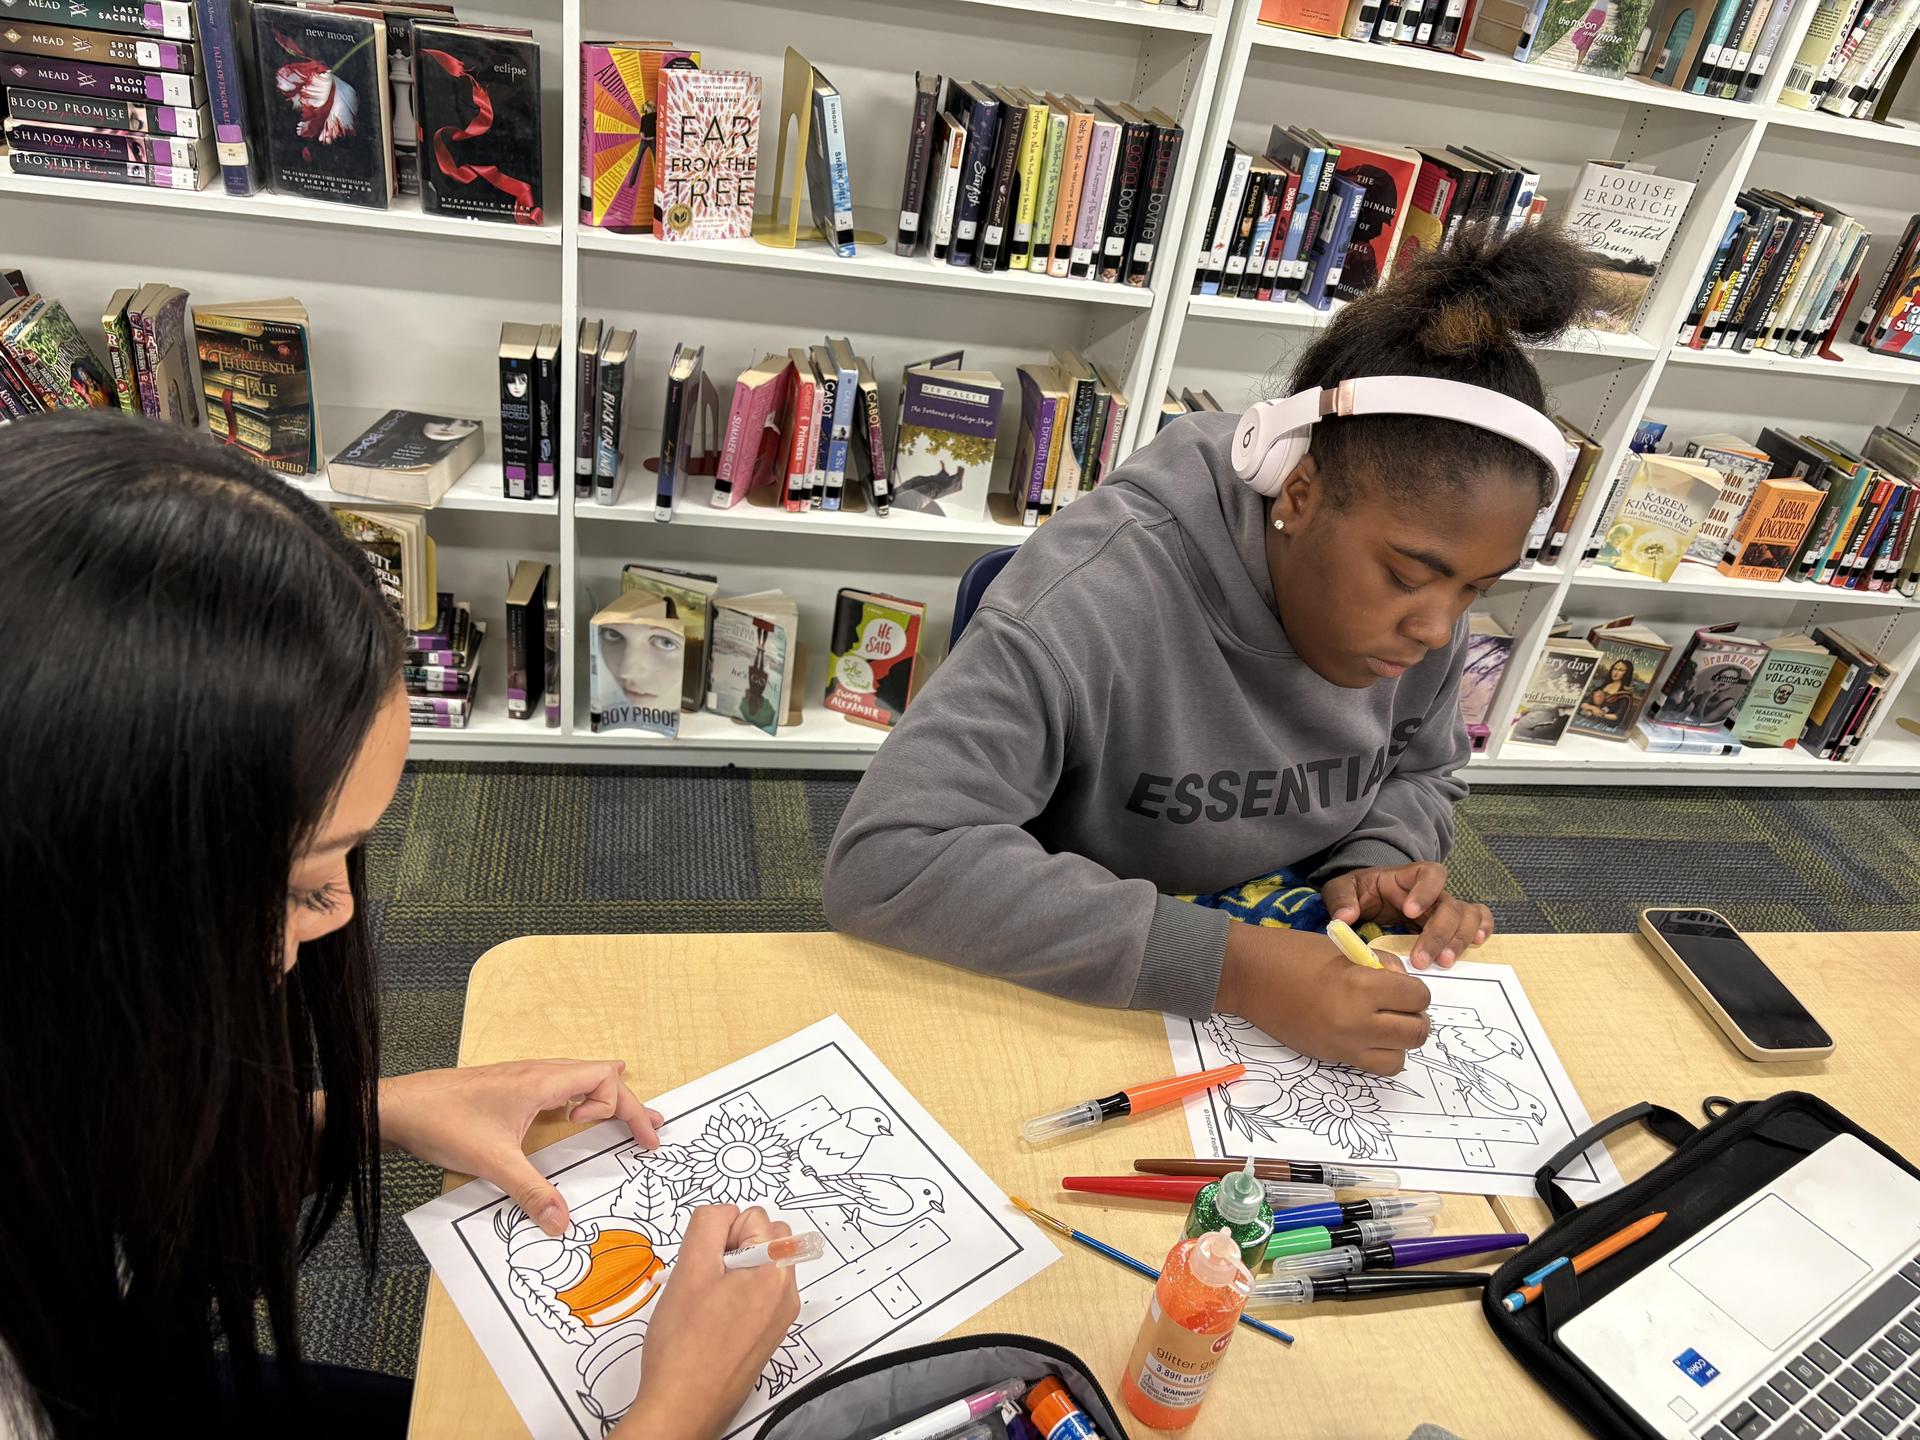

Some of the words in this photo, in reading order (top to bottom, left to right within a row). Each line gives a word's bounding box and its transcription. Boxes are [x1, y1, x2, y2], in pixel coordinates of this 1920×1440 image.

[113, 6, 139, 14] LAST
[1558, 17, 1571, 25] the
[1570, 18, 1597, 30] moon
[1739, 10, 1750, 36] PURE
[32, 35, 64, 46] MEAD
[305, 28, 324, 38] new
[326, 30, 356, 44] moon
[1593, 33, 1623, 44] more
[1732, 36, 1741, 50] CRY
[38, 69, 69, 81] MEAD
[114, 76, 146, 86] BLOO
[494, 63, 527, 83] eclipse
[11, 97, 58, 111] BLOOD
[65, 103, 125, 119] PROMISE
[695, 96, 715, 104] ROBIN
[716, 96, 740, 104] BENWAY
[830, 102, 838, 134] BINGHAM
[13, 130, 75, 145] SHADOW
[82, 137, 111, 149] KISS
[680, 115, 751, 149] FAR
[1128, 130, 1149, 138] BRAY
[15, 154, 91, 170] FROSTBITE
[672, 156, 720, 172] FROM
[726, 156, 756, 172] THE
[834, 152, 845, 181] SHARK
[1120, 144, 1143, 185] going
[282, 175, 337, 188] STEPHENIE
[342, 184, 372, 193] MEYER
[965, 161, 987, 207] Starfish
[1319, 162, 1336, 192] DRAPER
[1357, 175, 1375, 185] THE
[669, 176, 754, 208] TREE
[837, 182, 847, 202] GIRL
[1599, 174, 1677, 201] LOUISE
[441, 197, 495, 208] STEPHENIE
[501, 203, 531, 212] MEYER
[1248, 185, 1260, 215] DRAPER
[1282, 188, 1296, 211] DRAPER
[1349, 194, 1363, 218] DRAPER
[1364, 200, 1396, 215] DINARY
[1583, 188, 1678, 218] ERDRICH
[1114, 188, 1137, 235] bovine
[1142, 193, 1167, 239] bovine
[1359, 222, 1371, 231] OF
[1571, 211, 1602, 230] The
[1603, 219, 1672, 242] Painted
[1588, 230, 1635, 256] Drum
[1745, 239, 1761, 262] THIS
[1712, 257, 1726, 277] THE
[1741, 261, 1750, 273] IS
[1781, 252, 1795, 273] DYING
[1884, 245, 1904, 273] PLAYING
[1732, 272, 1746, 289] MY
[1772, 275, 1785, 291] WITH
[1877, 272, 1891, 289] WITH
[1698, 281, 1715, 309] DARE
[1767, 292, 1778, 308] YOU
[107, 334, 118, 346] R
[134, 329, 144, 341] E
[147, 336, 157, 347] A
[241, 337, 265, 351] THE
[207, 349, 296, 375] THIRTEENTH
[232, 373, 279, 398] TALE
[922, 385, 943, 395] DEB
[945, 388, 989, 403] CALETTI
[502, 403, 528, 411] NIGHT
[602, 391, 615, 427] BLACK
[822, 382, 836, 419] CABOT
[866, 391, 880, 428] CABOT
[911, 405, 921, 413] The
[502, 411, 530, 421] WORLD
[1043, 417, 1051, 426] a
[728, 415, 742, 458] SUMMER
[795, 425, 809, 461] Princess
[1037, 426, 1050, 460] breath
[1034, 461, 1045, 480] too
[1030, 480, 1042, 500] late
[1615, 476, 1630, 497] INTO
[1644, 492, 1689, 512] KAREN
[1773, 499, 1807, 521] BARBARA
[1623, 508, 1639, 517] Like
[1638, 510, 1673, 528] Dandelion
[1625, 499, 1697, 528] KINGSBURY
[1709, 508, 1730, 523] BARA
[1699, 521, 1729, 538] SOLVER
[1755, 518, 1807, 541] KINGSOLVER
[1737, 567, 1750, 576] THE
[1750, 567, 1764, 577] BEAN
[1764, 568, 1784, 579] TREES
[877, 623, 893, 640] HE
[865, 636, 891, 655] SAID
[731, 667, 747, 679] he's
[1568, 658, 1593, 673] day
[1768, 662, 1811, 675] UNDER
[1765, 673, 1822, 689] VOLCANO
[831, 697, 880, 719] ALEXANDER
[1539, 692, 1577, 706] levithan
[602, 707, 630, 726] BOY
[632, 706, 679, 728] PROOF
[1755, 709, 1792, 719] MALCOLM
[1157, 1347, 1197, 1369] glitter
[1156, 1364, 1182, 1382] 3.89fl
